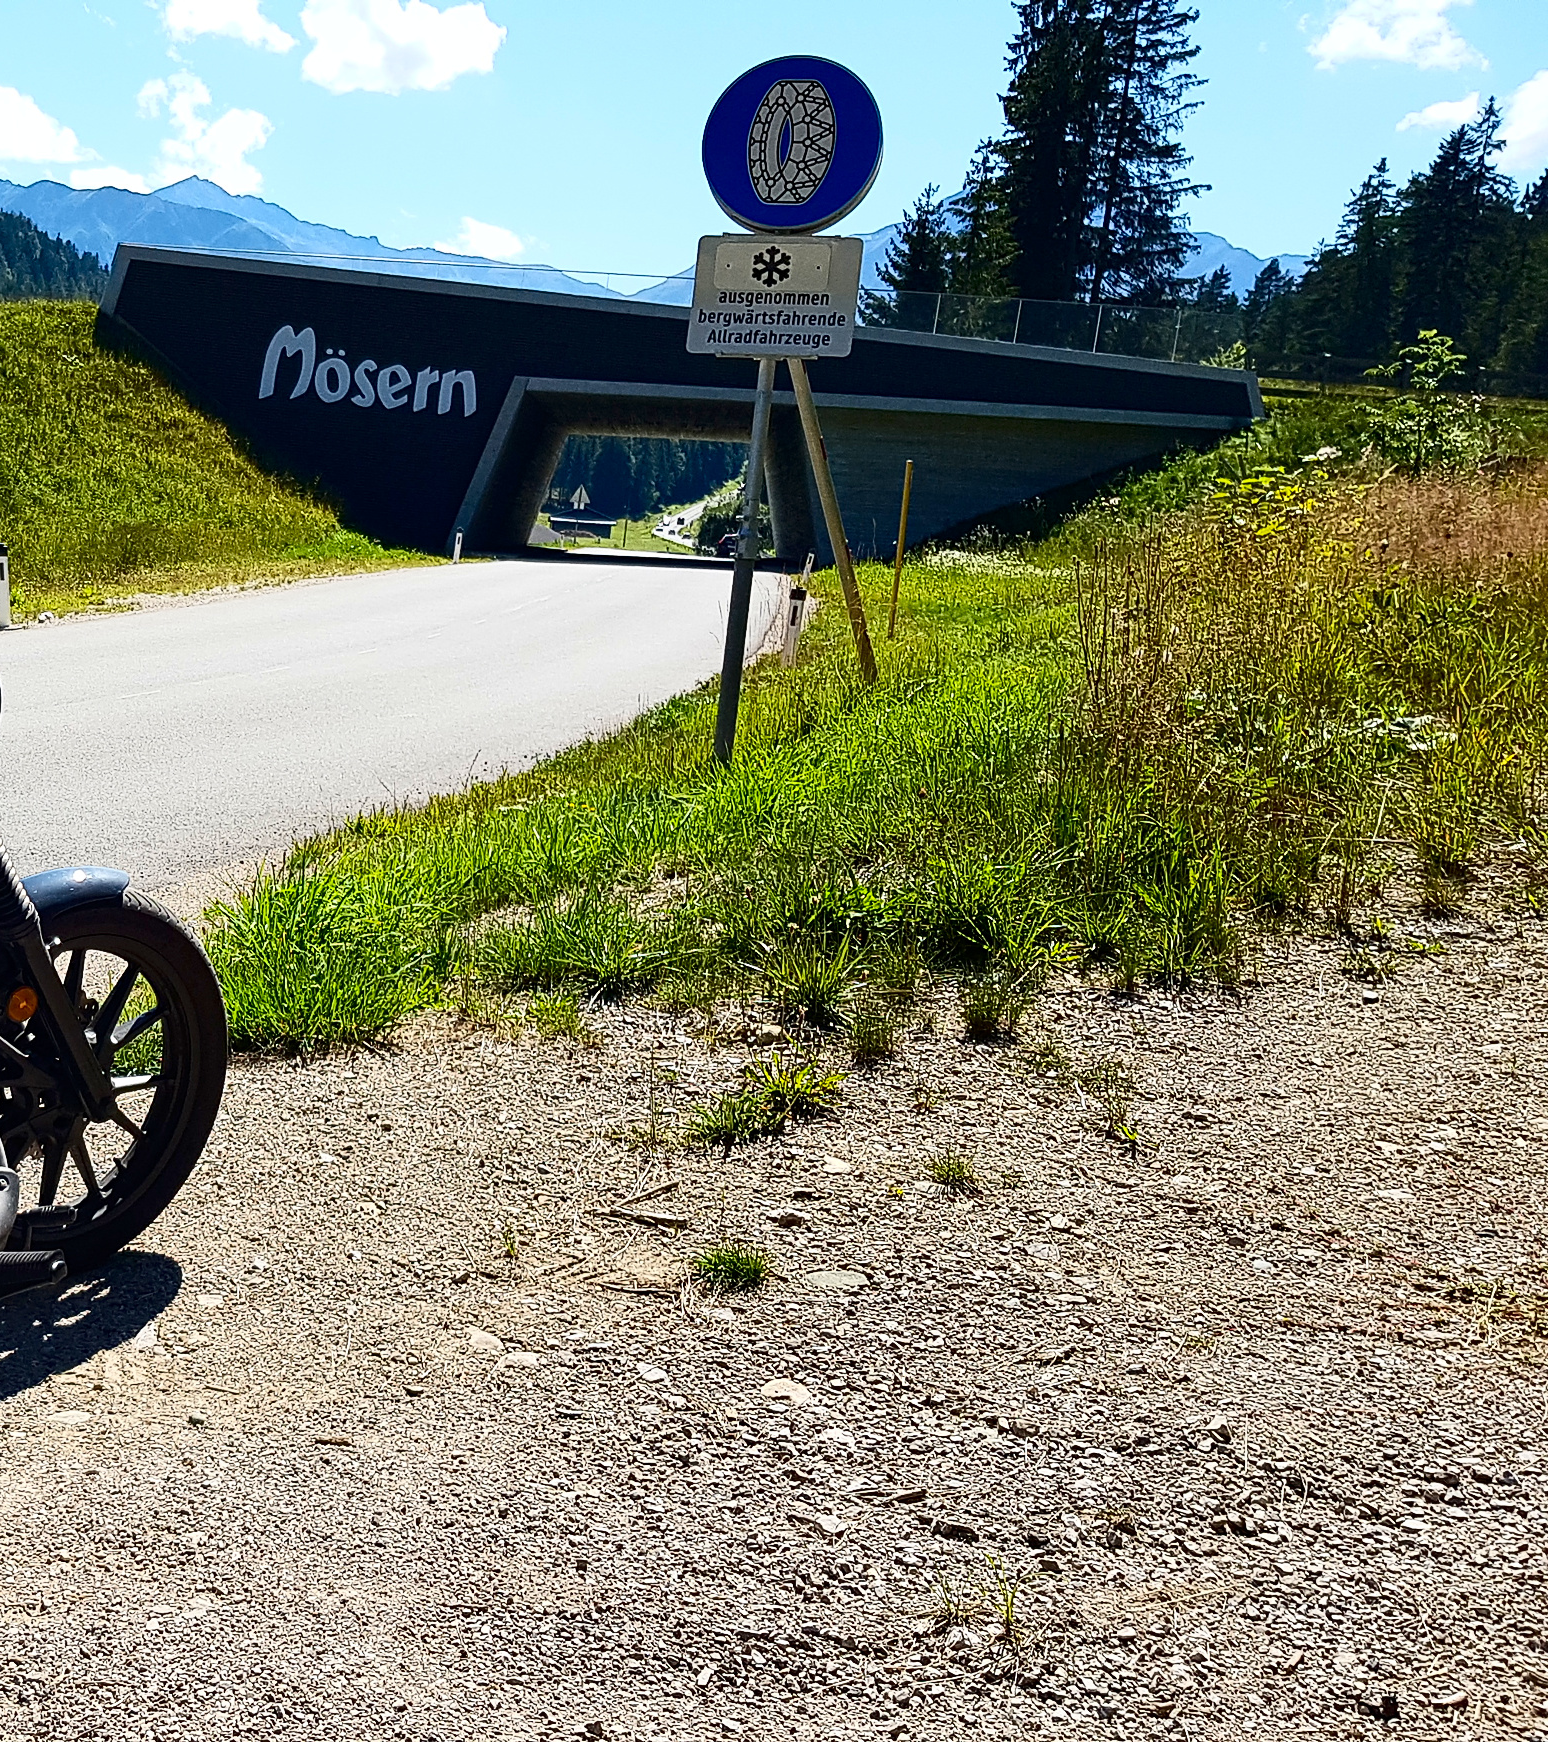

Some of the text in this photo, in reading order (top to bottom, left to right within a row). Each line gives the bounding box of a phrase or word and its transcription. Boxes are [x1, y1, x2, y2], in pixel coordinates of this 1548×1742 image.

[718, 291, 830, 307] ausgenommen
[698, 309, 846, 327] bergwärtsfahrende
[706, 329, 831, 348] Allradfahrzeuge
[258, 324, 477, 418] Mösern
